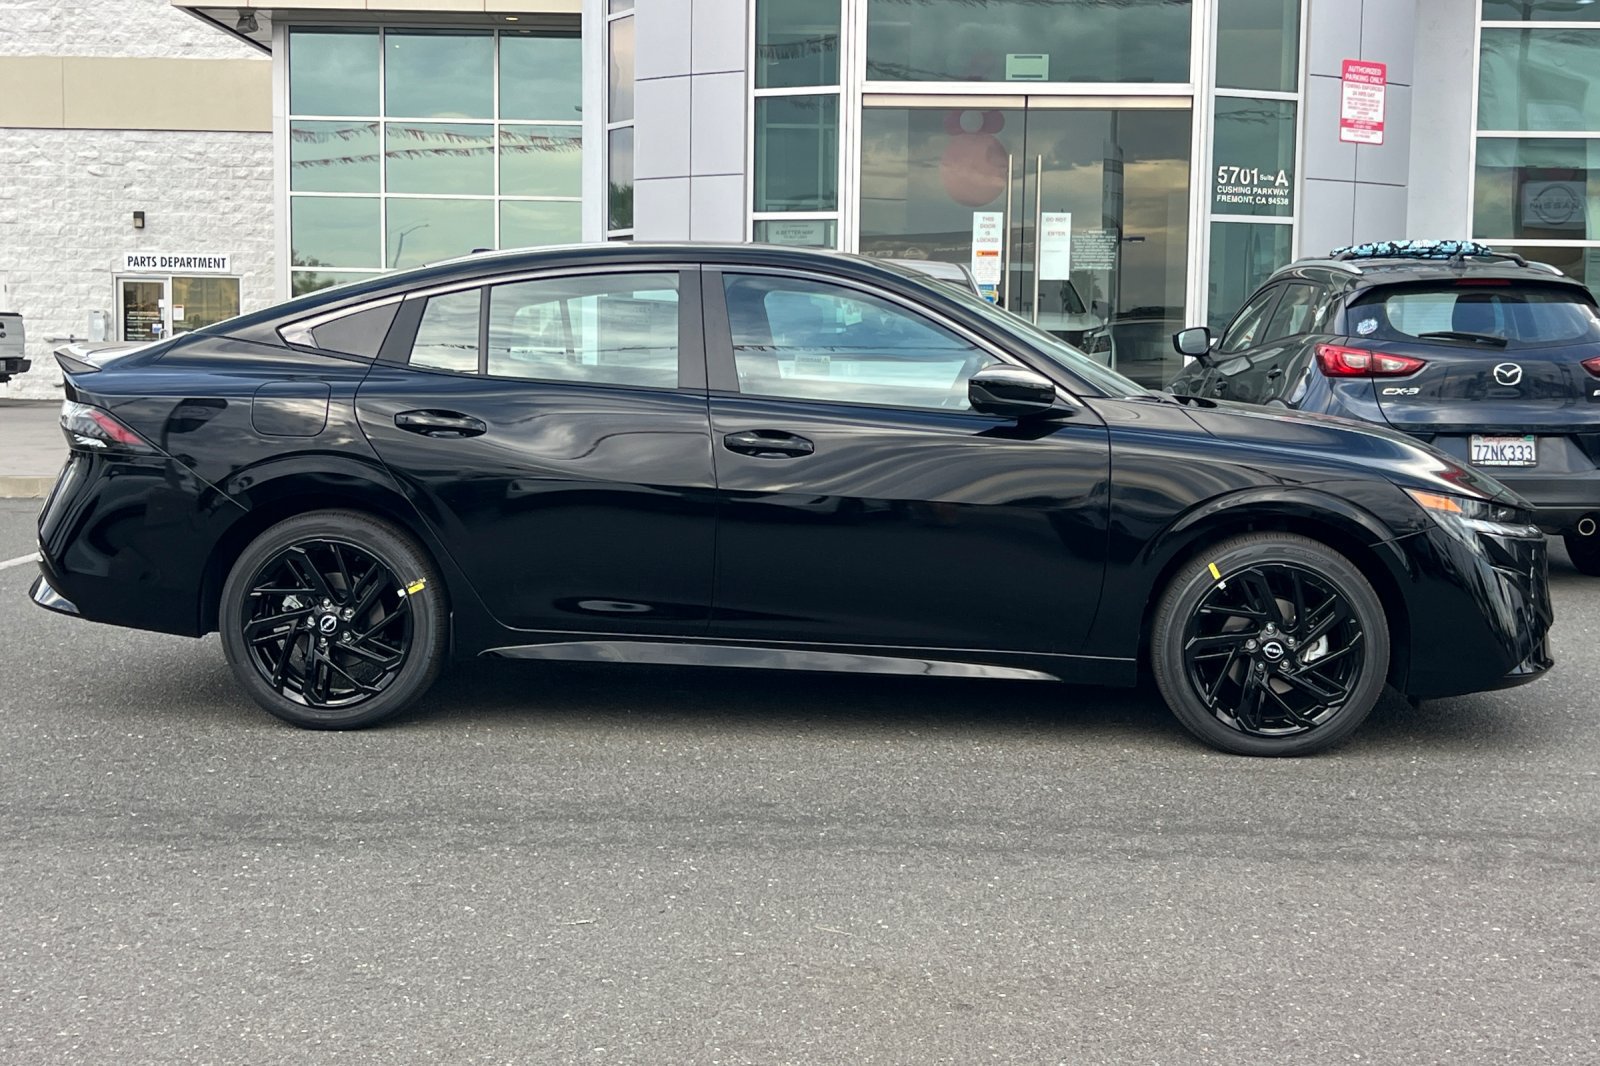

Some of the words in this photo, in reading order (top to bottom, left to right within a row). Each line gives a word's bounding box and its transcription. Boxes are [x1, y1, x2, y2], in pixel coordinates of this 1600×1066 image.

[1348, 65, 1382, 76] AUTHORIZED
[1345, 73, 1369, 83] PARKING
[1369, 76, 1384, 84] ONLY
[1217, 165, 1258, 185] 5701
[1259, 174, 1275, 182] Suite
[1275, 169, 1289, 187] A
[1216, 185, 1251, 194] CUSHING
[1252, 187, 1289, 196] PARKWAY
[1216, 194, 1254, 205] FREMONT,
[1255, 197, 1267, 205] CA
[1267, 197, 1289, 205] 94538
[127, 255, 157, 268] PARTS
[160, 256, 226, 269] DEPARTMENT
[1382, 387, 1420, 396] CX-3
[1473, 444, 1533, 461] 7ZNK333
